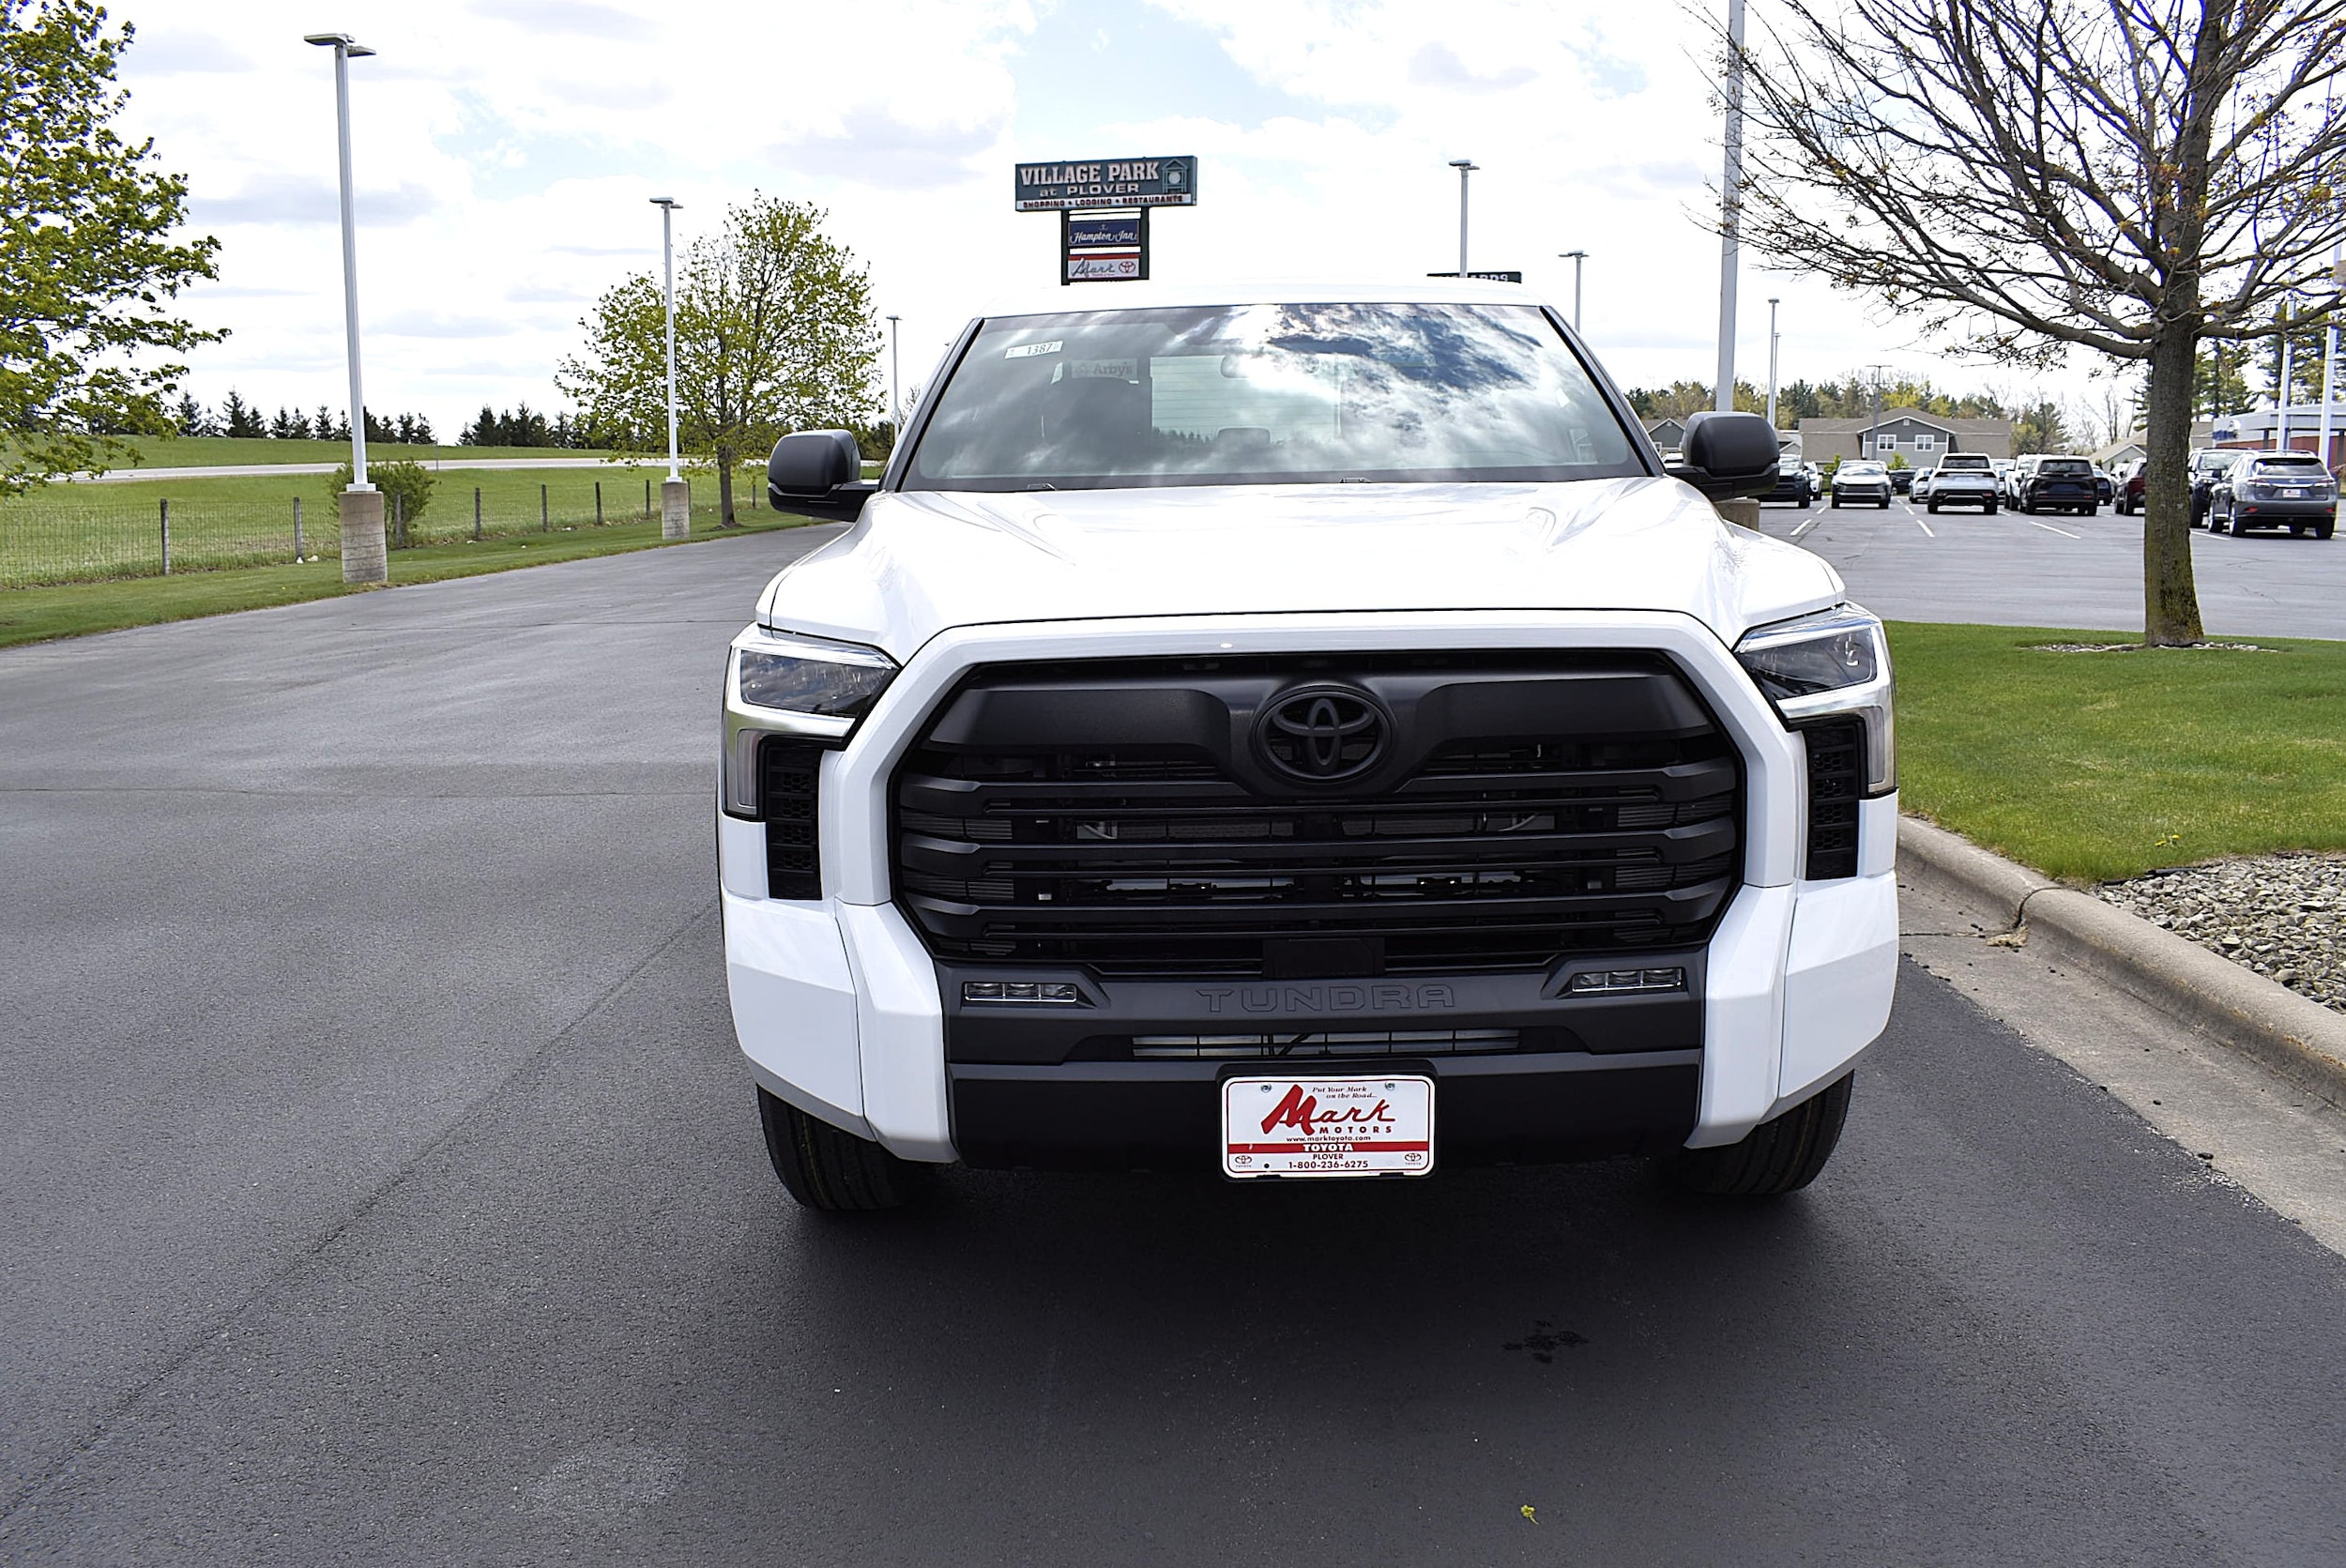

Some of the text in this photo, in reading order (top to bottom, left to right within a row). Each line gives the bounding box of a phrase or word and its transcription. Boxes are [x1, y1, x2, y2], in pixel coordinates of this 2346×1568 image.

[1020, 161, 1160, 185] VILLAGE PARK
[1039, 183, 1139, 197] at PLOVER
[1023, 195, 1183, 208] SHOPPING LODGING RESTAURANTS
[1070, 230, 1137, 243] Hampton Inn
[1072, 257, 1116, 277] Mark
[1027, 343, 1053, 356] 1387
[1093, 361, 1133, 377] Arby's
[1196, 983, 1455, 1013] TUNDRA
[1260, 1084, 1395, 1135] Mark
[1318, 1125, 1393, 1134] MOTORS
[1286, 1134, 1371, 1143] www.marktoyota.com
[1302, 1143, 1353, 1152] TOYOTA
[1288, 1160, 1369, 1169] 1-800-236-6275
